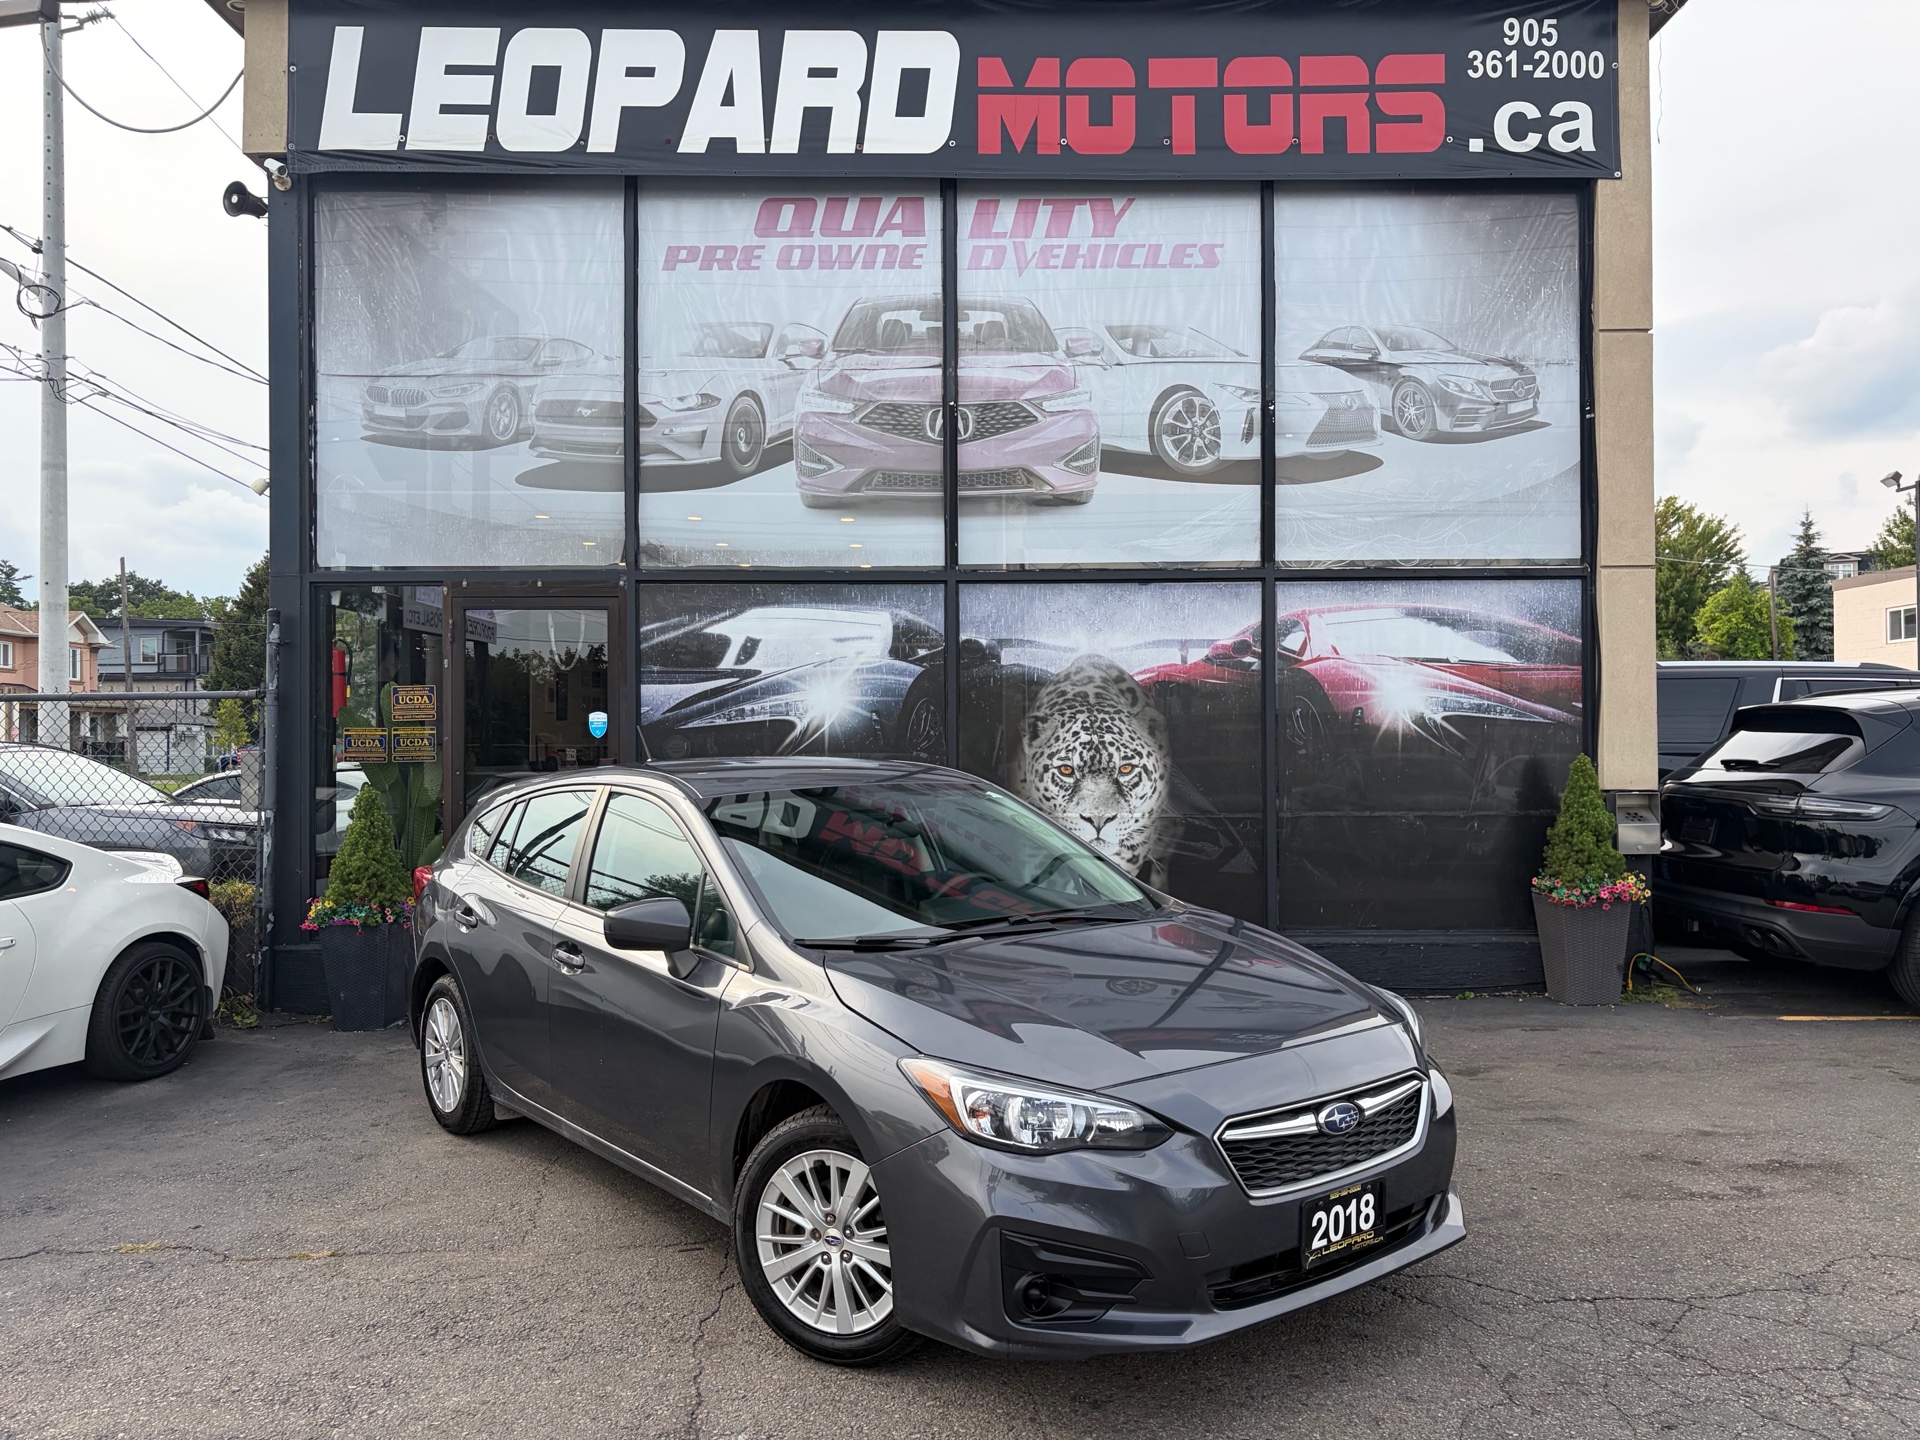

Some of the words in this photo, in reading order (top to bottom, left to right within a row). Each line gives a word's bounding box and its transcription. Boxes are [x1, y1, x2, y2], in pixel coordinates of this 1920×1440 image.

[1503, 17, 1558, 47] 905
[1466, 50, 1605, 80] 361-2000
[318, 25, 960, 154] LEOPARD
[977, 53, 1446, 155] MOTORS
[1468, 100, 1597, 153] .ca
[661, 244, 766, 271] PRE
[398, 695, 430, 704] UCDA
[351, 739, 381, 747] UCDA
[399, 738, 430, 747] UCDA
[1311, 1192, 1376, 1250] 2018
[1322, 1230, 1375, 1255] LEOPARD
